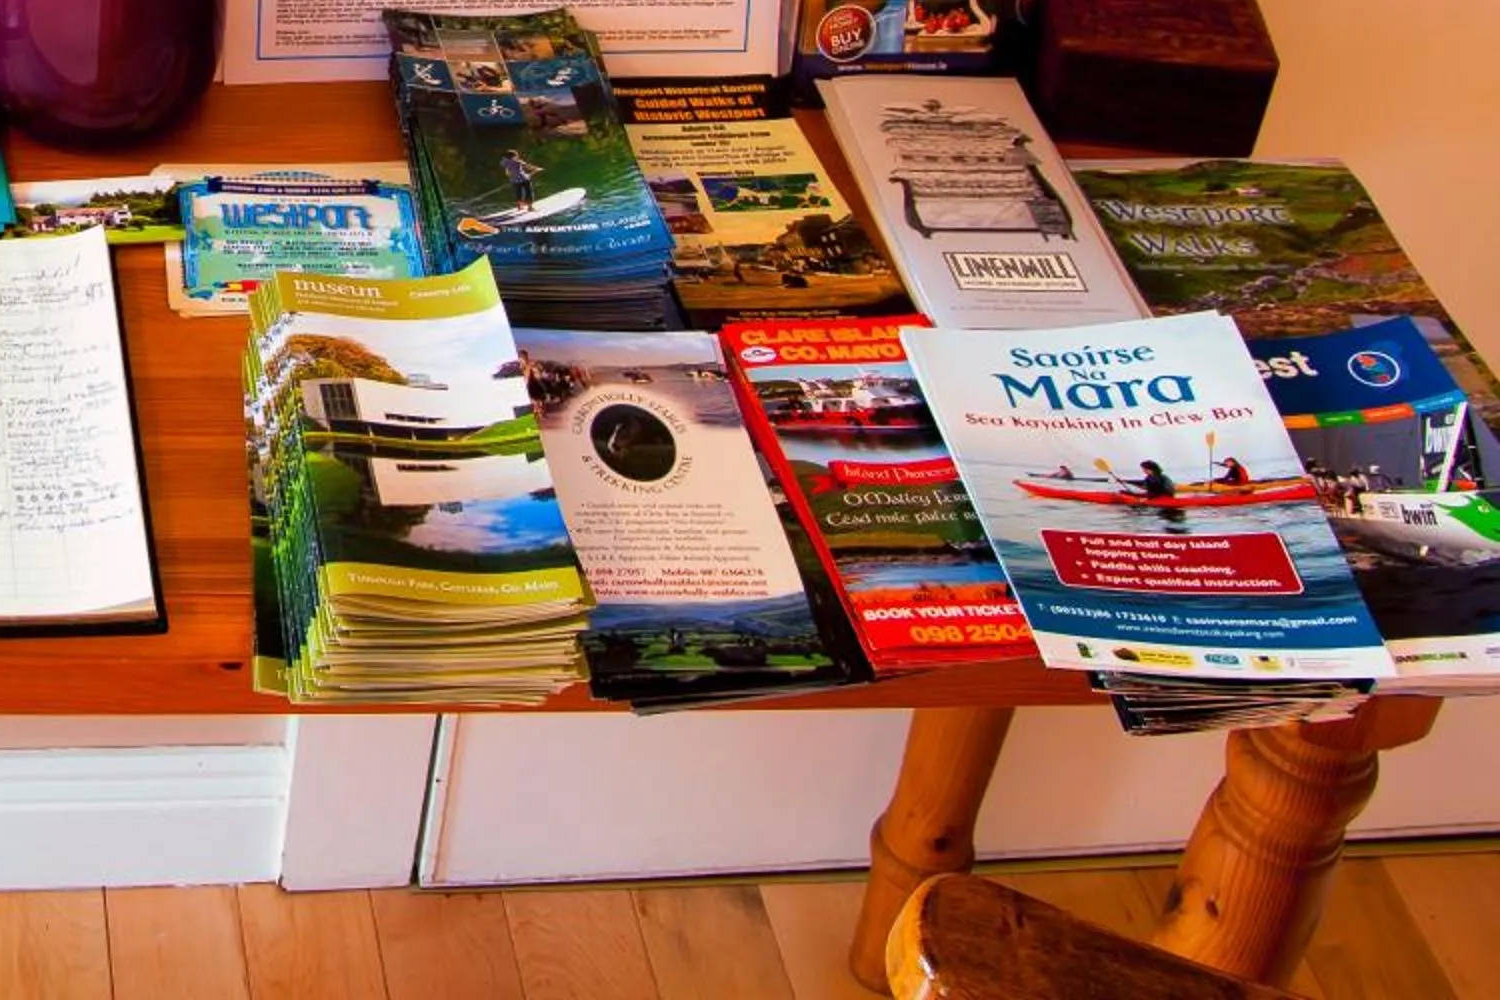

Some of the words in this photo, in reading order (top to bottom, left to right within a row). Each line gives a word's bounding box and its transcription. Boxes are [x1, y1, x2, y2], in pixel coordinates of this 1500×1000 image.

[831, 28, 861, 47] BUY
[635, 97, 687, 109] Guided
[690, 96, 736, 107] Walks
[738, 95, 753, 105] of
[634, 110, 694, 121] Historic
[695, 108, 765, 120] Westport
[1101, 200, 1290, 226] Westport
[1128, 232, 1259, 257] Walks
[950, 253, 1078, 280] LINENMILL
[292, 279, 381, 299] museum
[741, 328, 830, 345] CLARE
[826, 343, 901, 360] MAYO
[1009, 344, 1155, 369] Saoirse
[1069, 368, 1107, 381] Na
[993, 373, 1197, 412] Mara
[965, 412, 1004, 426] Sea
[1011, 413, 1114, 433] Kayaking
[1120, 416, 1143, 429] In
[1149, 411, 1204, 427] Clew
[1211, 406, 1255, 421] Bay
[1401, 504, 1438, 525] bwin
[1079, 536, 1105, 545] Full
[1109, 539, 1132, 547] and
[1135, 540, 1159, 548] half
[1164, 541, 1186, 550] day
[1085, 548, 1139, 561] hopping
[1141, 551, 1180, 560] tours.
[1090, 560, 1135, 571] Paddle
[1138, 563, 1171, 572] skills
[1174, 565, 1236, 576] coaching.
[1095, 573, 1142, 585] Expert
[1144, 576, 1201, 587] qualified
[1204, 578, 1282, 587] instruction.
[862, 606, 912, 622] BOOK
[916, 604, 964, 618] YOUR
[910, 625, 964, 643] 098
